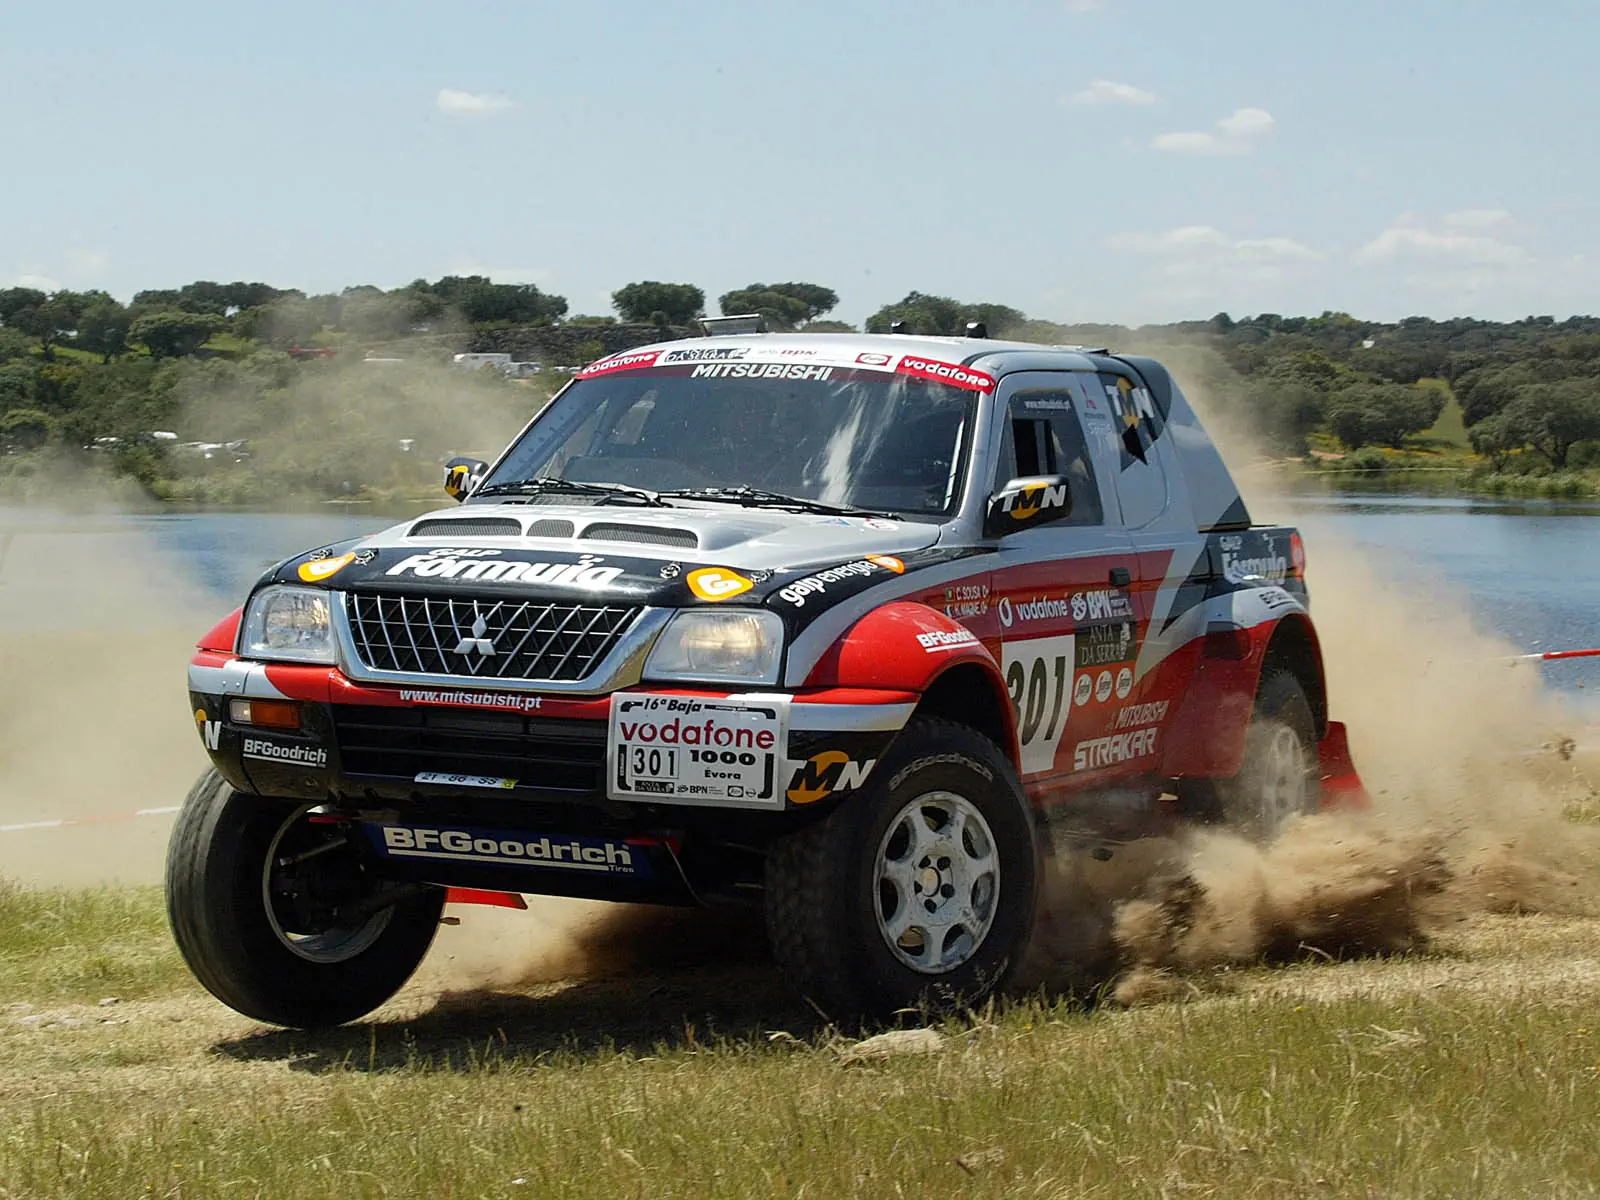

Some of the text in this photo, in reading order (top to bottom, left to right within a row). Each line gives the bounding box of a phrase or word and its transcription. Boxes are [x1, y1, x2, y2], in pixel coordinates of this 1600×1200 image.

[582, 354, 656, 374] vodafone
[691, 364, 831, 381] MITSUBISHI
[904, 358, 990, 387] vodafone
[1001, 485, 1067, 512] TMN
[429, 548, 503, 557] GALP
[779, 560, 879, 608] galp energia
[1016, 597, 1067, 620] vodafone
[1086, 589, 1113, 619] BPN
[400, 690, 542, 710] www.mitsubishi.pt
[667, 700, 702, 714] Baja
[1007, 656, 1066, 746] 301
[620, 718, 775, 749] vodafone
[243, 739, 327, 762] BFGoodrich
[690, 750, 756, 766] 1000
[1074, 728, 1158, 770] STRAKAR
[633, 748, 675, 776] 301
[704, 769, 741, 780] Évora
[383, 827, 632, 865] BFGoodrich
